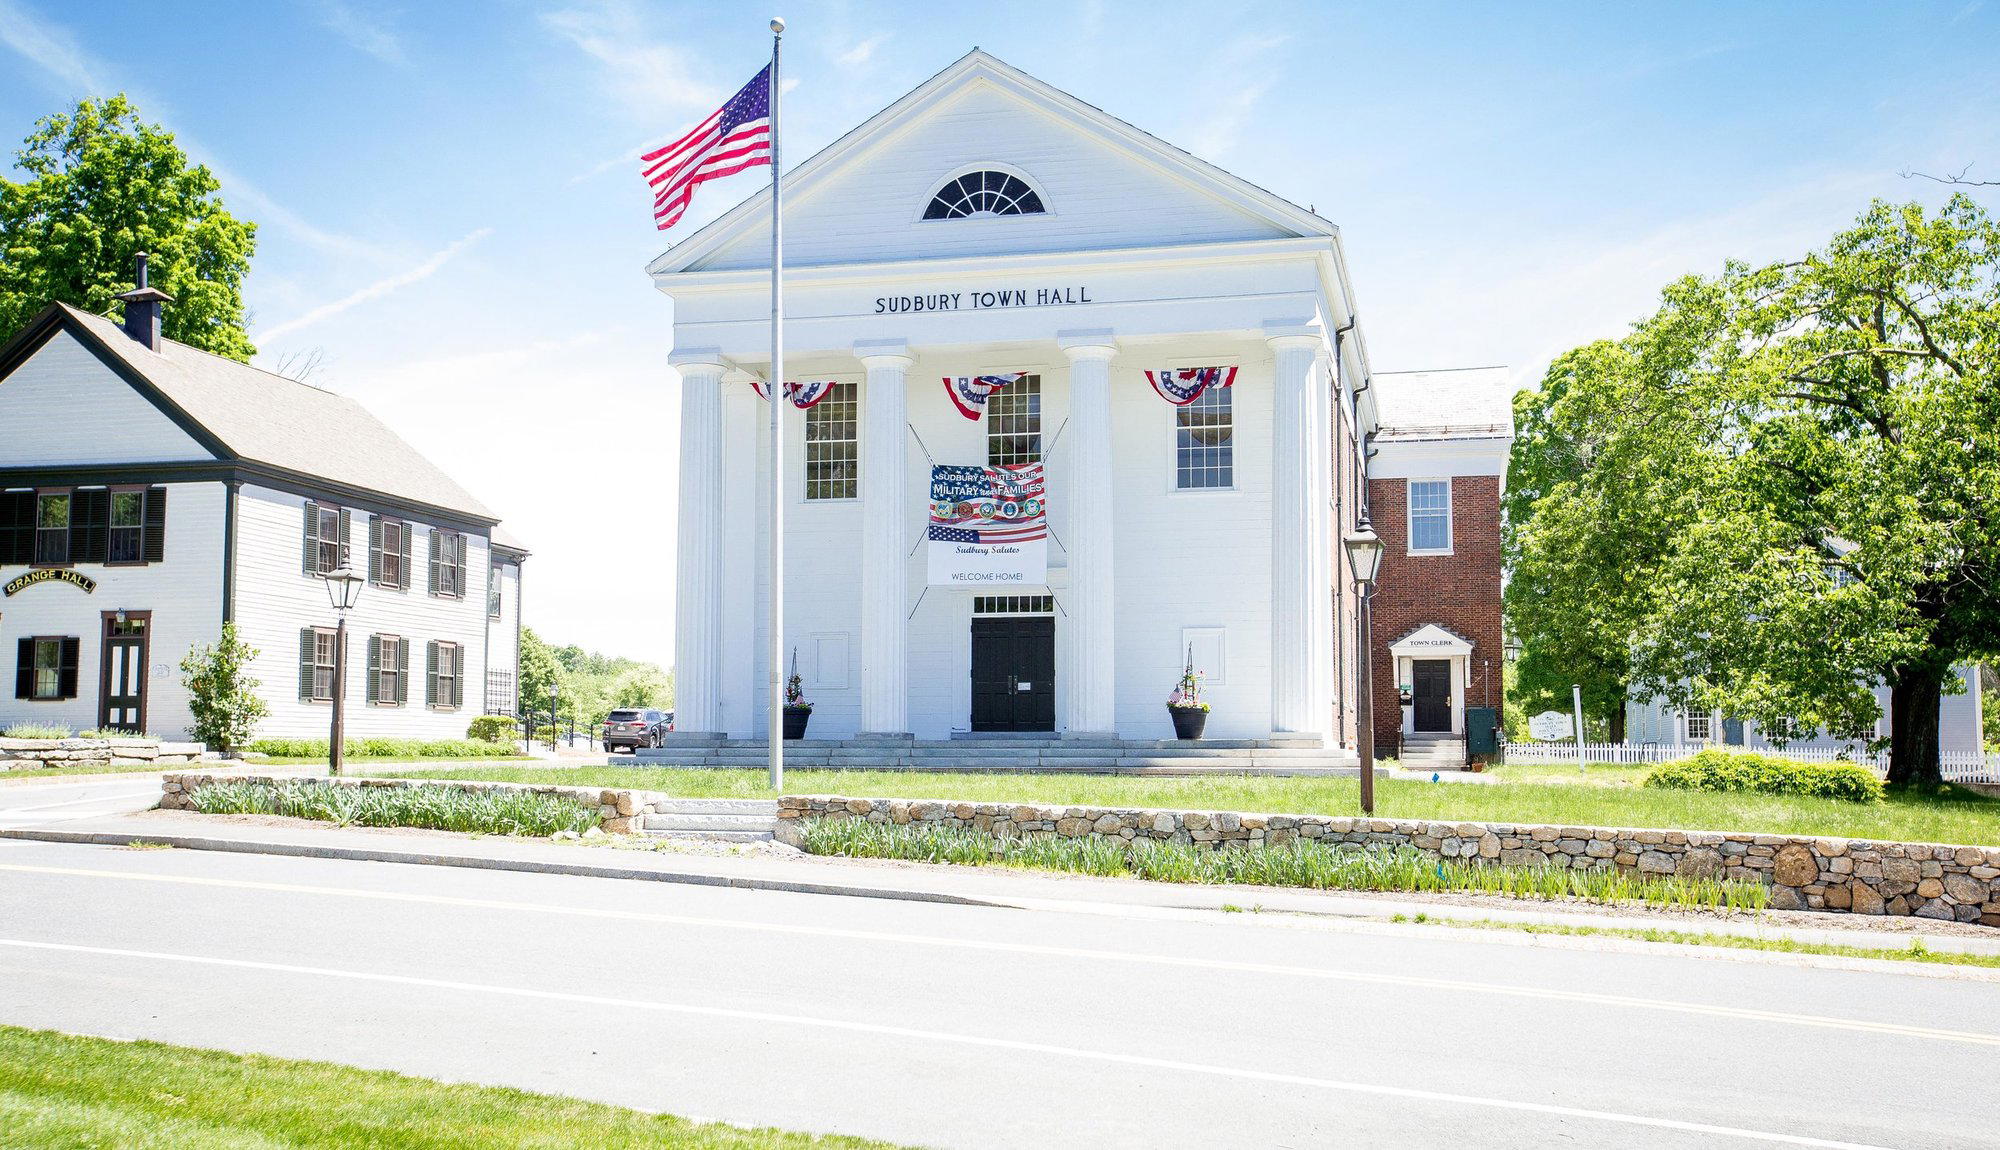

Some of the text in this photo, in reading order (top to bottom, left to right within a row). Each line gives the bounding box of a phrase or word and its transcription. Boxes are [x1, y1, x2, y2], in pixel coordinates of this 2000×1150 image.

[875, 287, 1092, 313] SUDBURY TOWN HALL
[938, 471, 1037, 482] SUDBURY SALUTES OUR
[933, 484, 979, 496] MILITARY
[998, 483, 1042, 495] FAMILIES
[955, 545, 1020, 556] Sudbury Salutes
[7, 569, 90, 593] GRANGE HALL
[952, 572, 1023, 581] WELCOME HOME!
